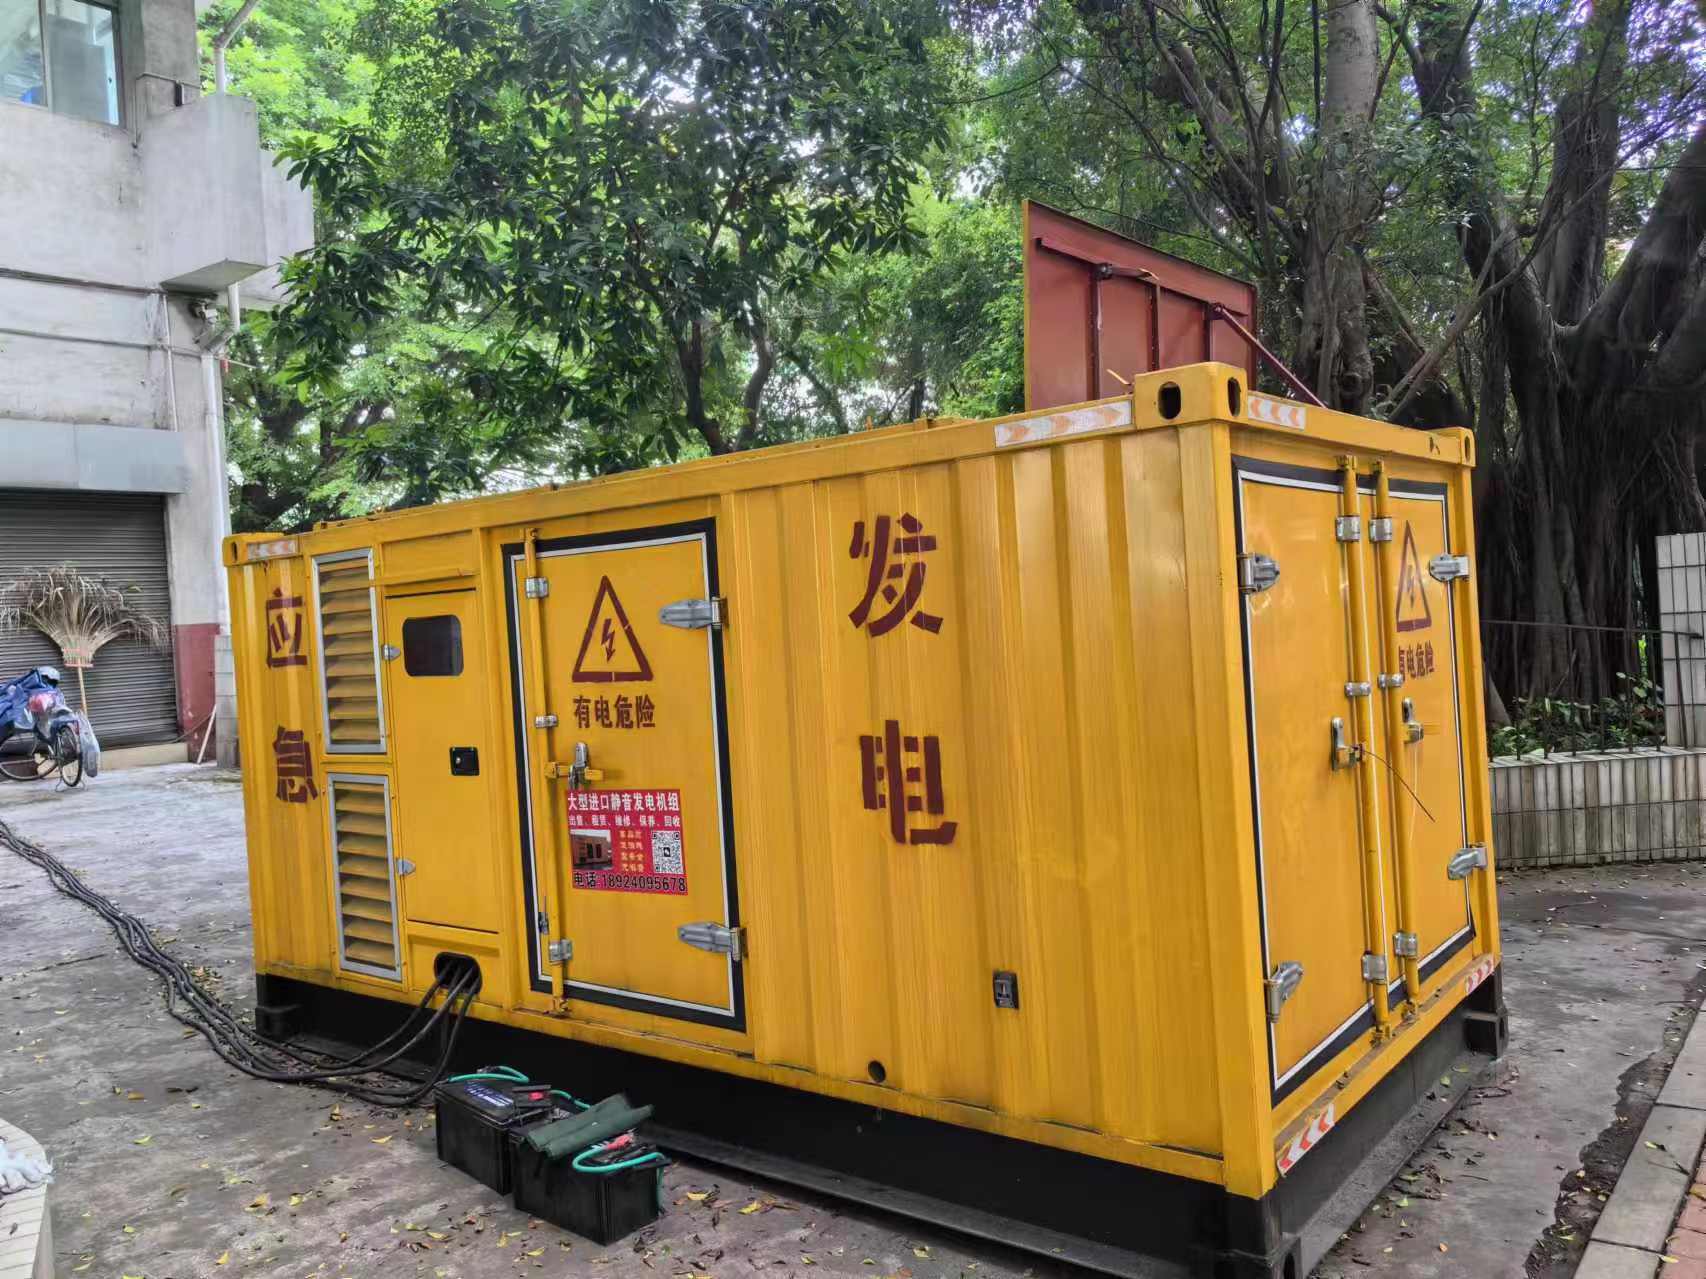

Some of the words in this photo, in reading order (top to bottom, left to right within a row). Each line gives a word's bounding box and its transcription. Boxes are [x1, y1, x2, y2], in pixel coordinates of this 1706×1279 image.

[573, 694, 656, 729] 有电危险
[568, 792, 680, 811] 大型进口静音发电机组
